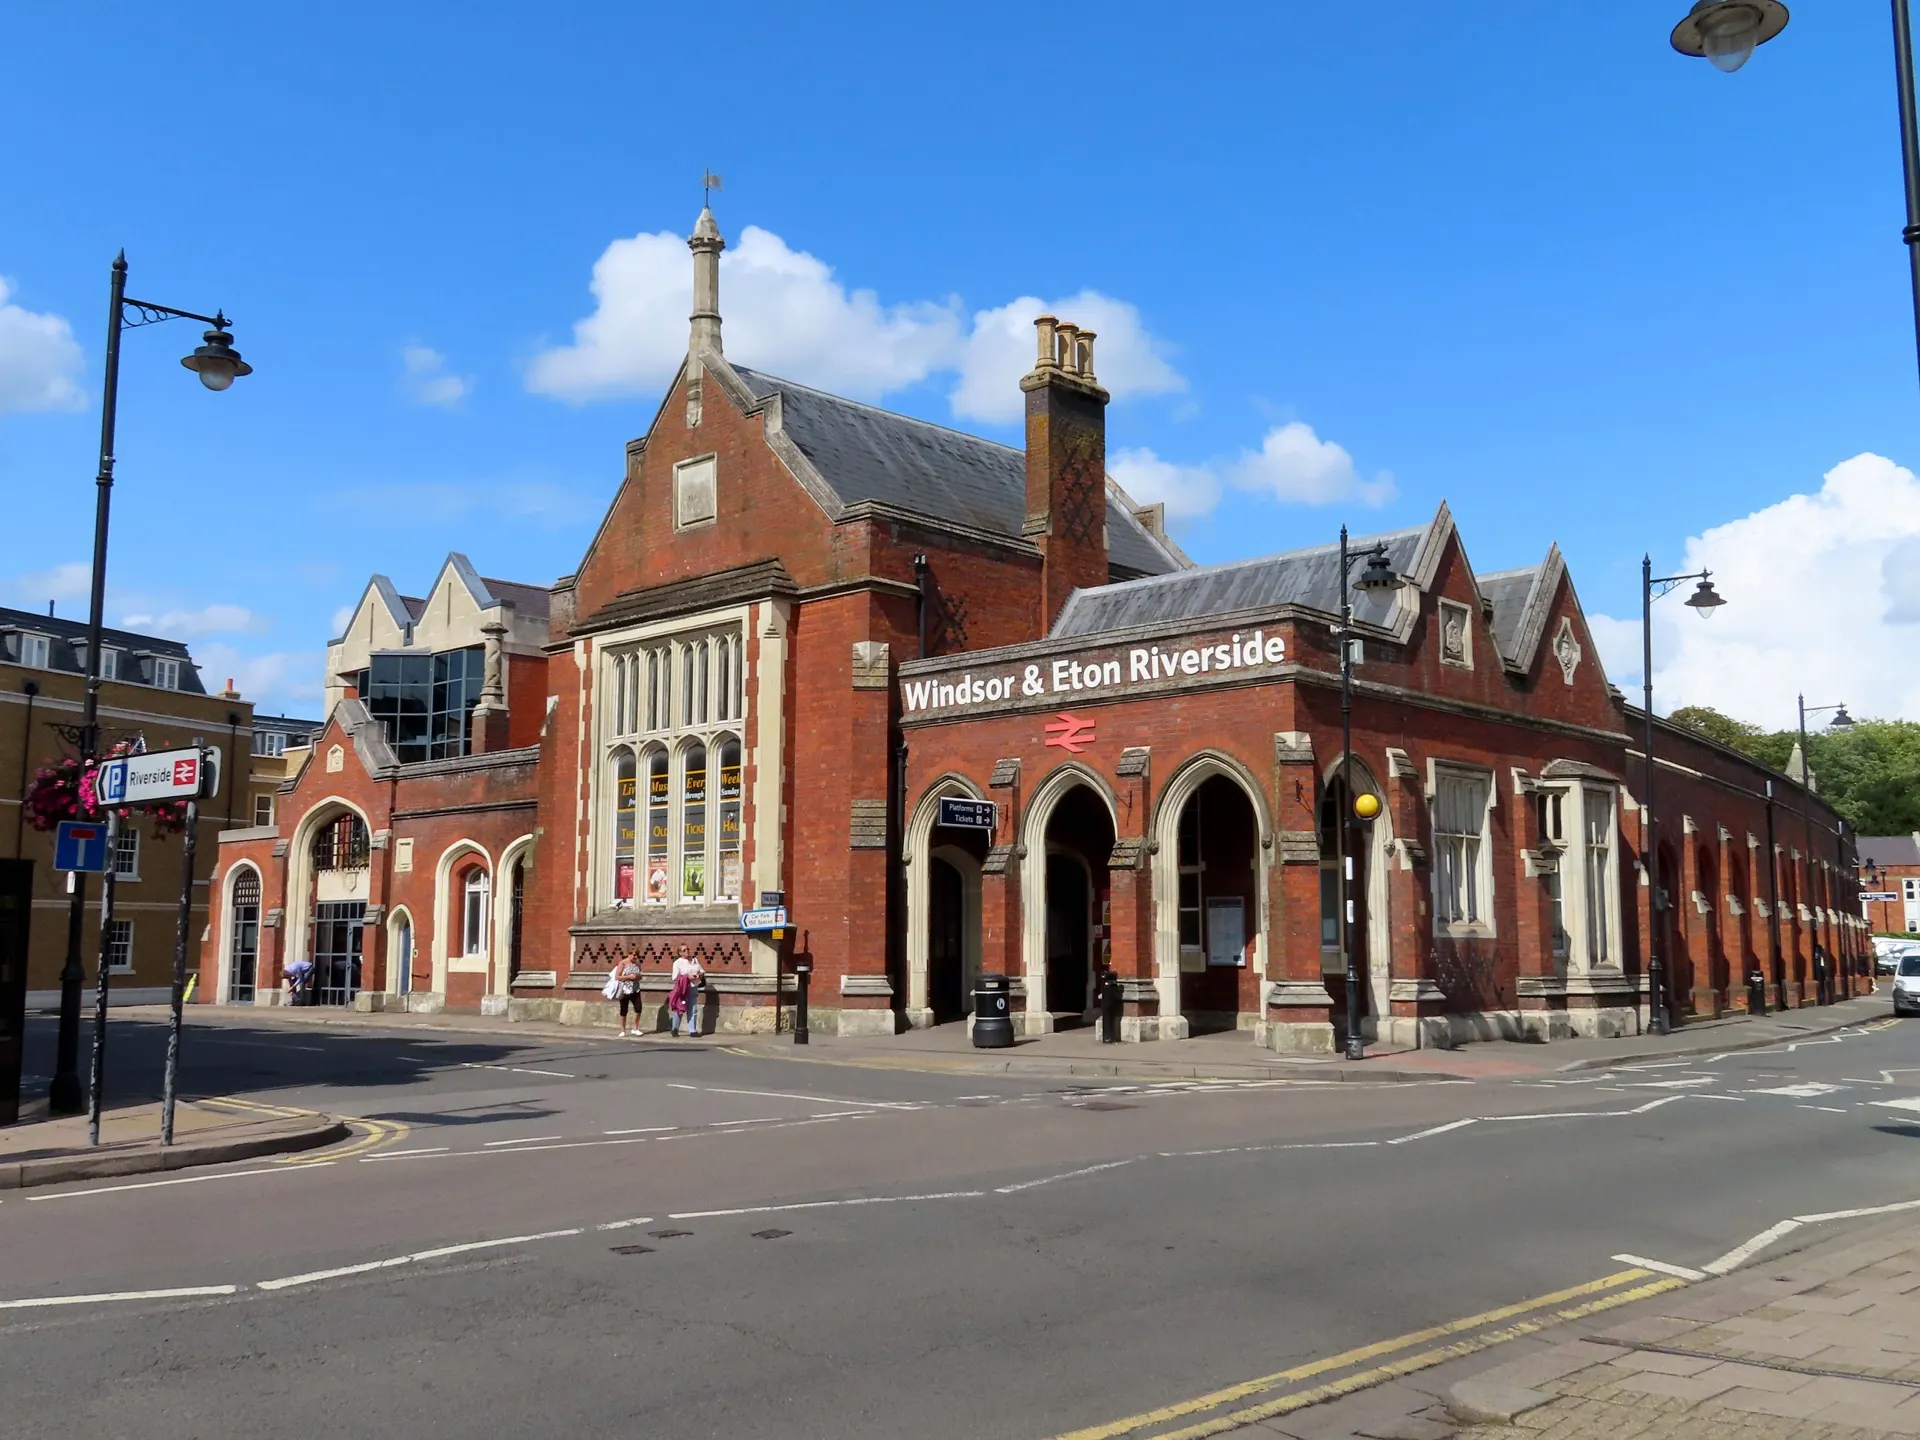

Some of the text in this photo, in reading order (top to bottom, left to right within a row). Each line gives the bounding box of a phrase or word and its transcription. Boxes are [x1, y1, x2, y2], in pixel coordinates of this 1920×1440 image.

[904, 630, 1285, 711] Windsor & Eton Riverside
[129, 767, 171, 787] Riverside
[949, 804, 973, 812] Platforms
[955, 814, 973, 823] Tickets
